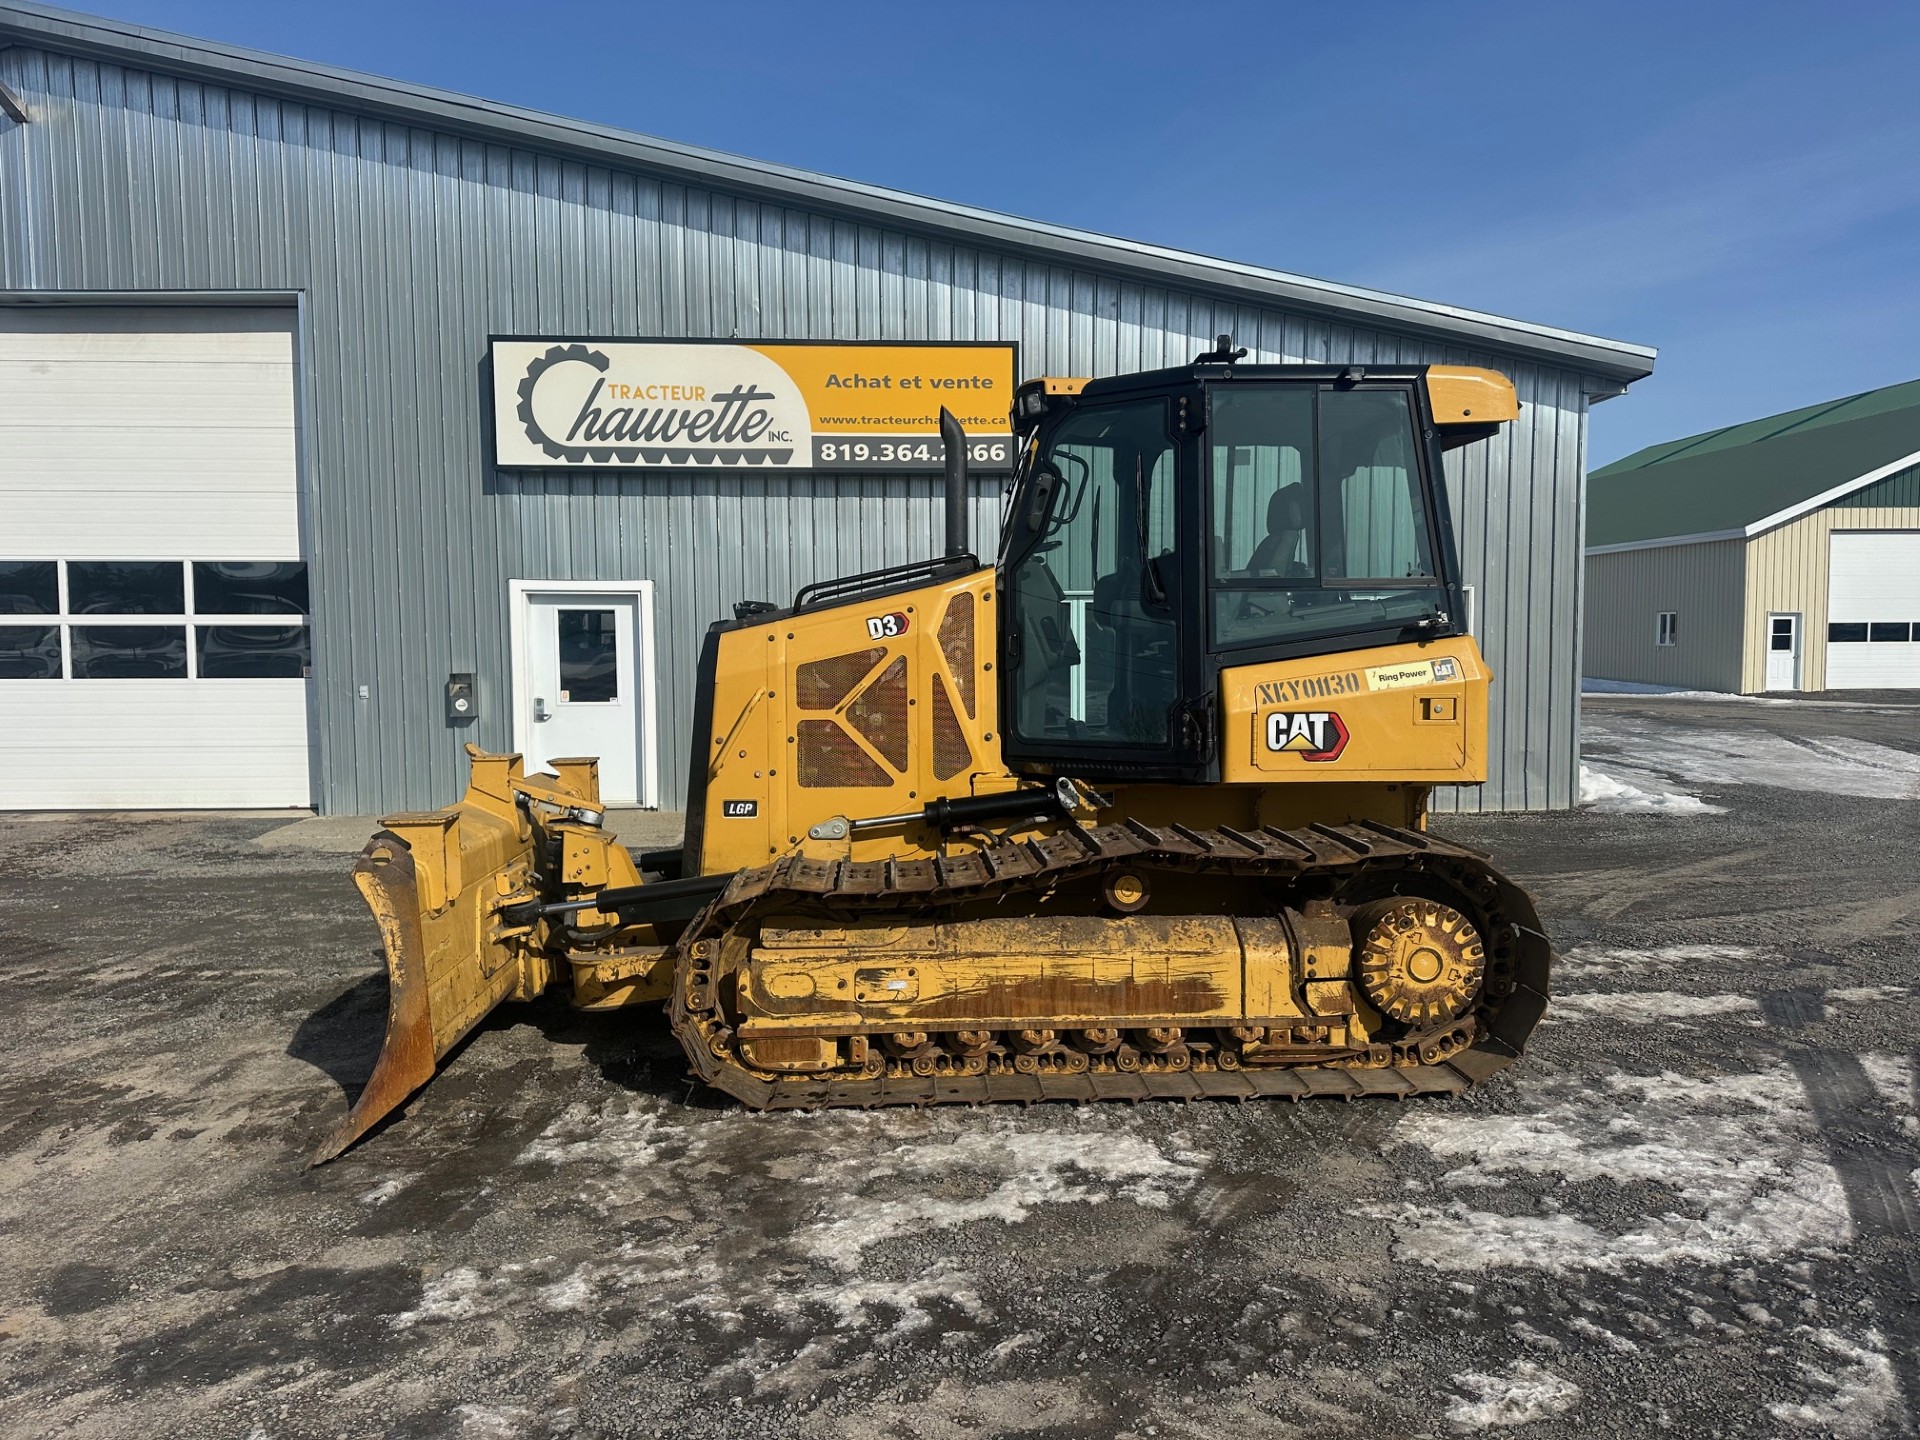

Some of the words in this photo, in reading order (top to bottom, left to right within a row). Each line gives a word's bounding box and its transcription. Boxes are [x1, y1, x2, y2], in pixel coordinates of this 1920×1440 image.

[825, 374, 891, 388] Achat
[899, 376, 922, 389] et
[929, 376, 993, 389] vente
[608, 384, 705, 401] TRACTEUR
[517, 344, 775, 460] Chauvette
[820, 415, 1006, 425] www.tracteurchaette.ca
[768, 430, 793, 443] INC.
[867, 615, 897, 639] D3
[1378, 673, 1399, 683] Ring
[1399, 669, 1427, 681] Power
[1434, 664, 1453, 676] CAT
[1267, 713, 1329, 750] CAT
[728, 803, 753, 814] LGP
